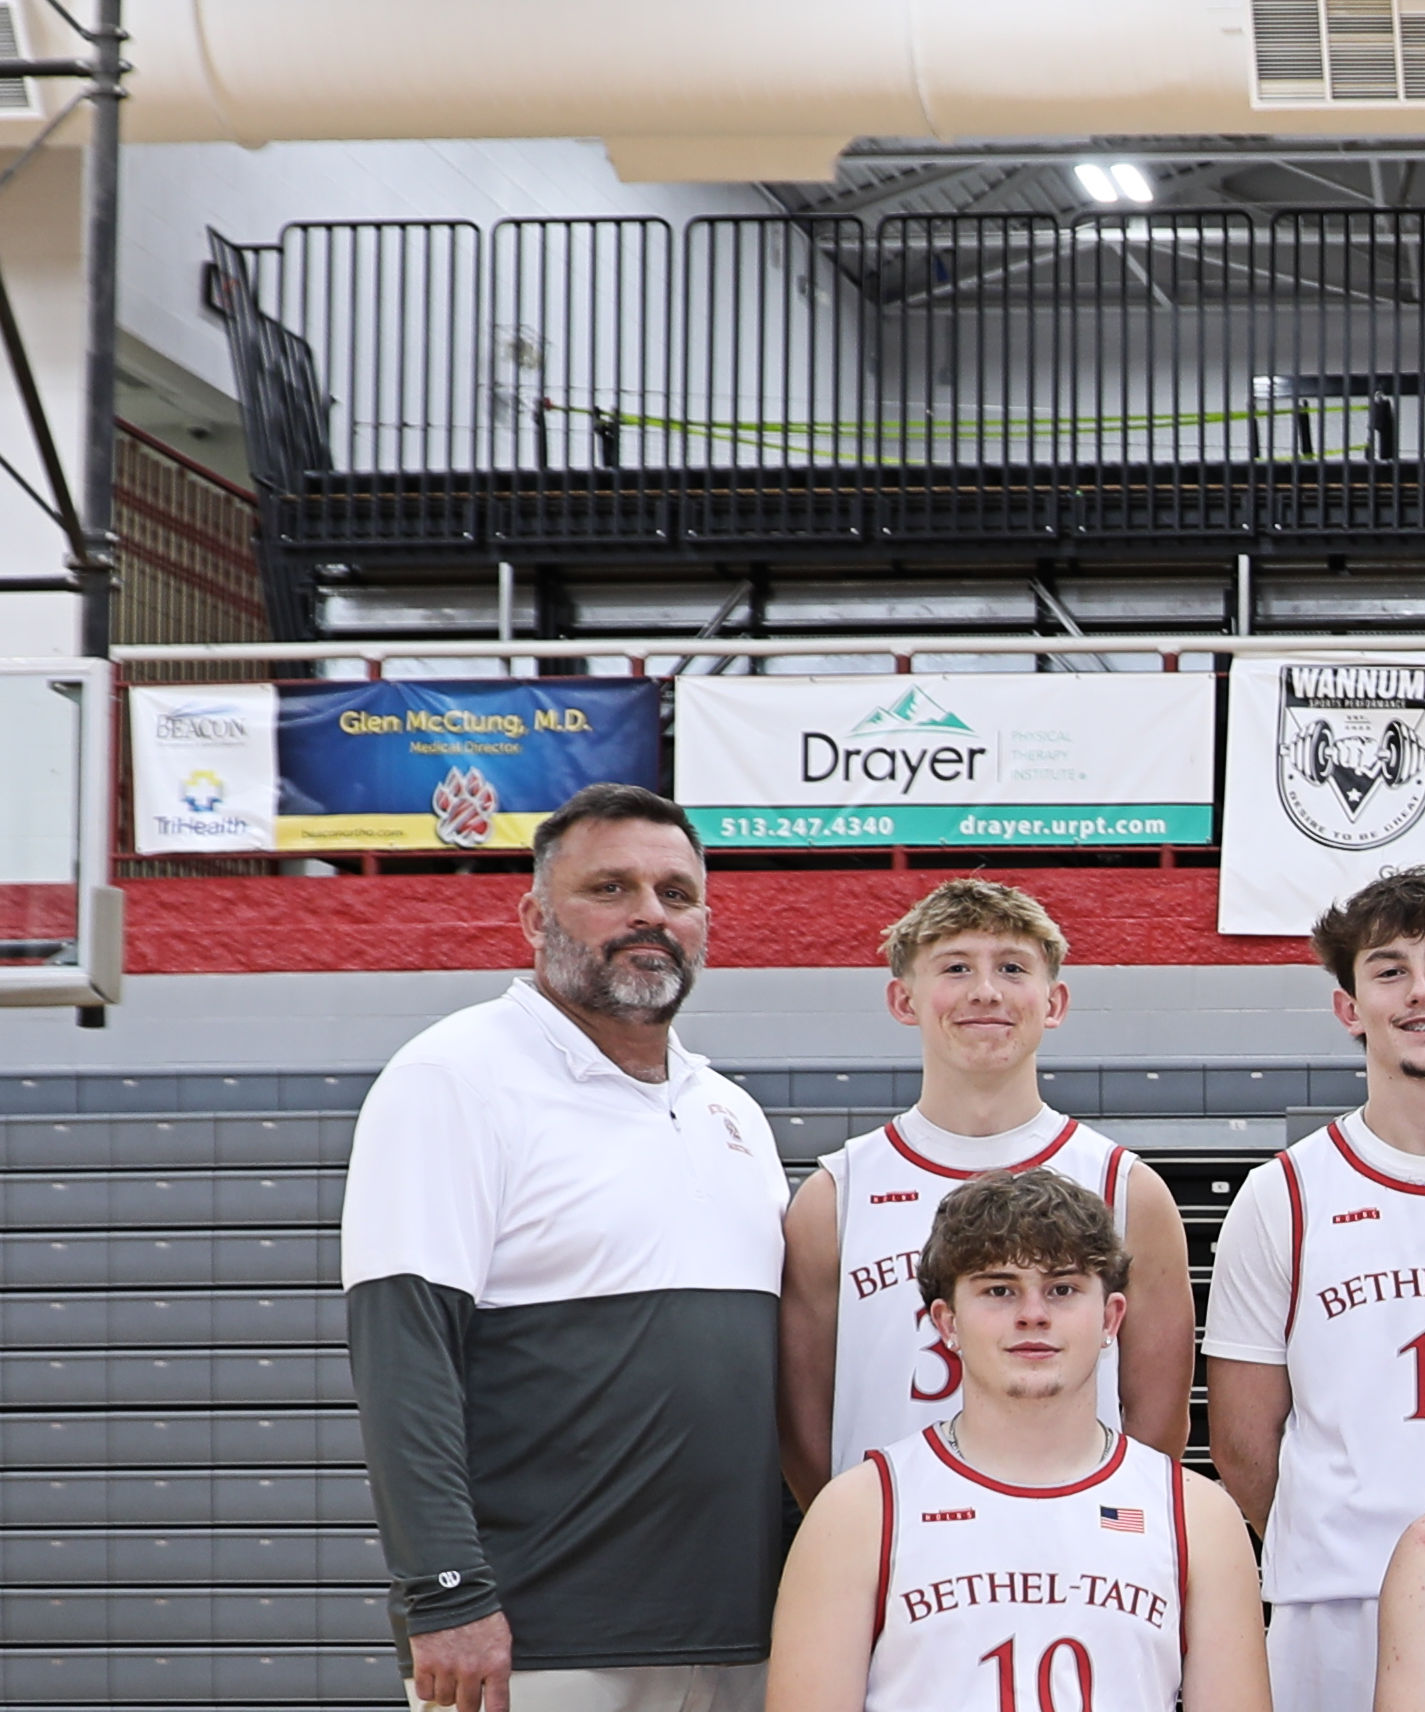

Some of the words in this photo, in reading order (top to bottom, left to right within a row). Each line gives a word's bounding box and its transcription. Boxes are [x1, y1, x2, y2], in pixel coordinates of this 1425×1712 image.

[1291, 667, 1425, 700] WANNUM
[339, 710, 402, 735] Glen
[405, 709, 528, 738] McClung,
[534, 708, 592, 733] M.D.
[410, 741, 461, 754] Medical
[464, 741, 520, 754] Director
[802, 732, 986, 795] Drayer
[154, 816, 248, 836] TriHealth
[720, 816, 895, 838] 513.247.4340
[959, 814, 1167, 841] drayer.urpt.com
[900, 1572, 1168, 1629] BETHEL-TATE
